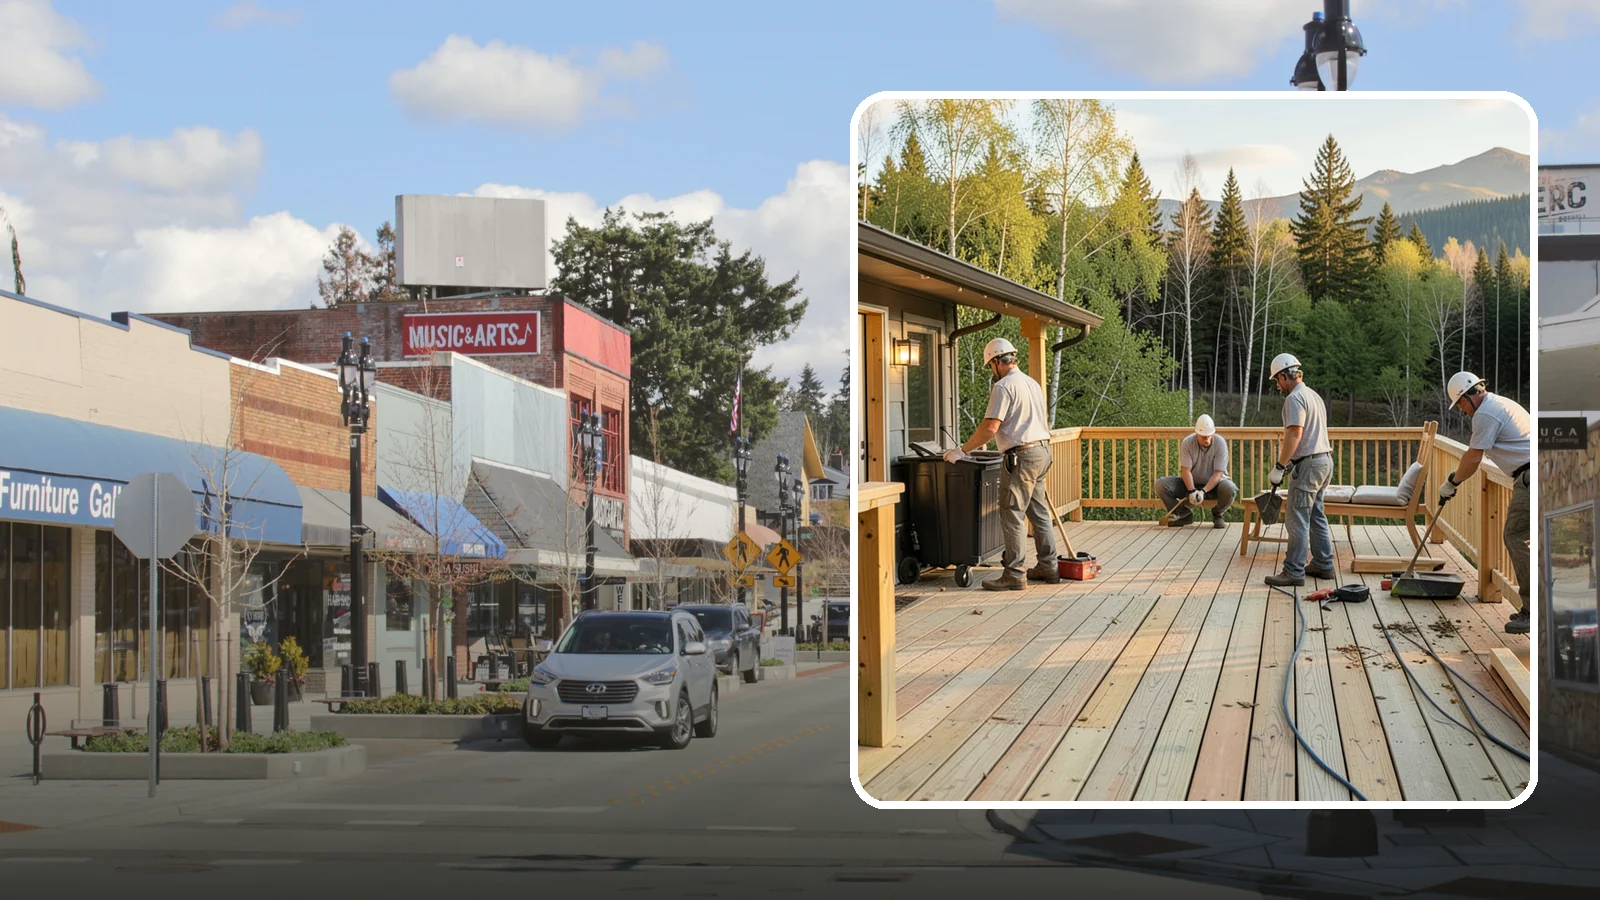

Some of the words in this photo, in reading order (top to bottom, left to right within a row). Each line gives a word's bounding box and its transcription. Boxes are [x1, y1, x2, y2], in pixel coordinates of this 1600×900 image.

[409, 323, 519, 349] MUSIC&ARTS
[0, 471, 79, 516] Furniture
[89, 482, 122, 519] Gal
